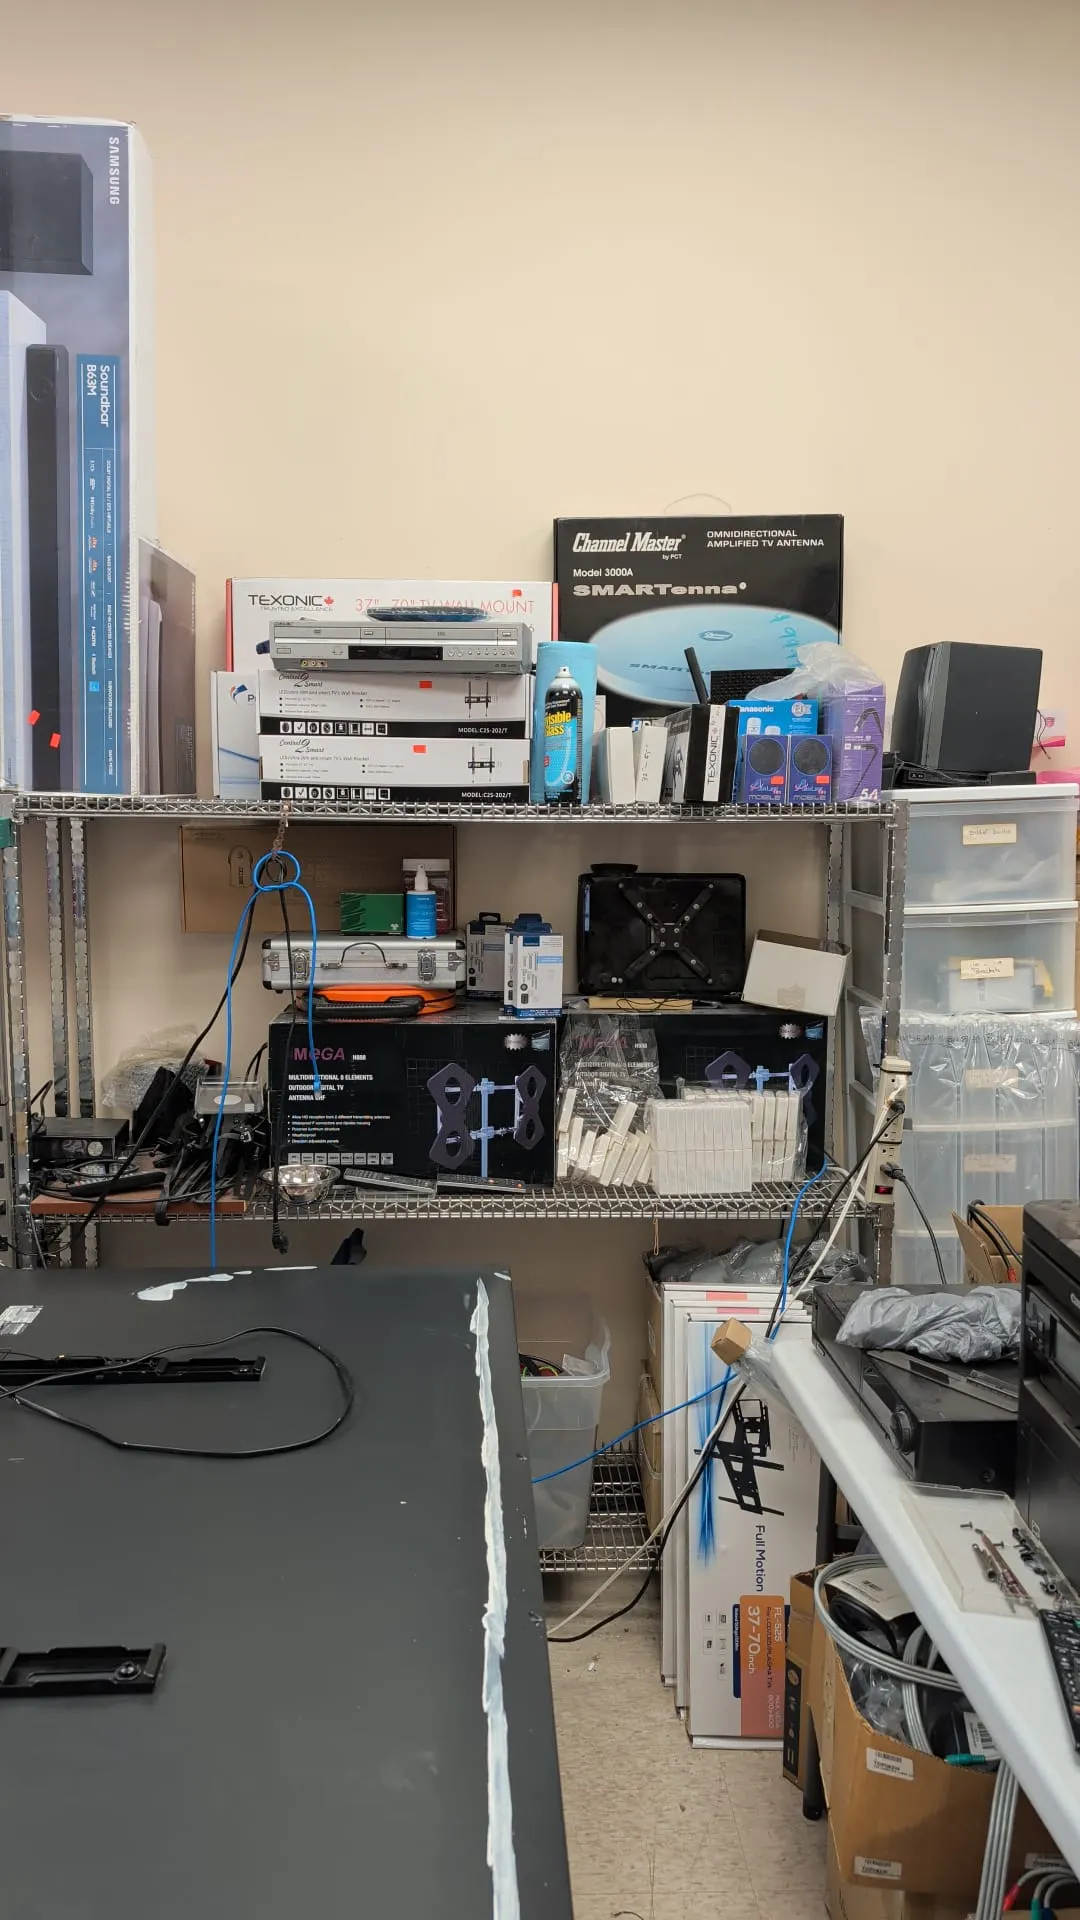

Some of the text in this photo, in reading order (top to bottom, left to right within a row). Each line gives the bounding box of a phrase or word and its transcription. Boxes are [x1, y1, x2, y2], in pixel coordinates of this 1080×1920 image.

[108, 136, 120, 205] SAMSUNG
[86, 363, 97, 396] B63M
[100, 364, 110, 427] Soundbar
[572, 532, 683, 552] Channel Master
[706, 530, 798, 538] OMNIDIRECTIONAL
[706, 538, 825, 547] AMPLIFIED TV ANTENNA
[573, 568, 633, 577] Model 3000A
[572, 584, 738, 596] SMARTenna
[248, 595, 323, 606] TEXONIC
[480, 600, 535, 614] MOUNT
[707, 735, 719, 785] TEXONIC
[755, 1525, 766, 1592] Full Motion
